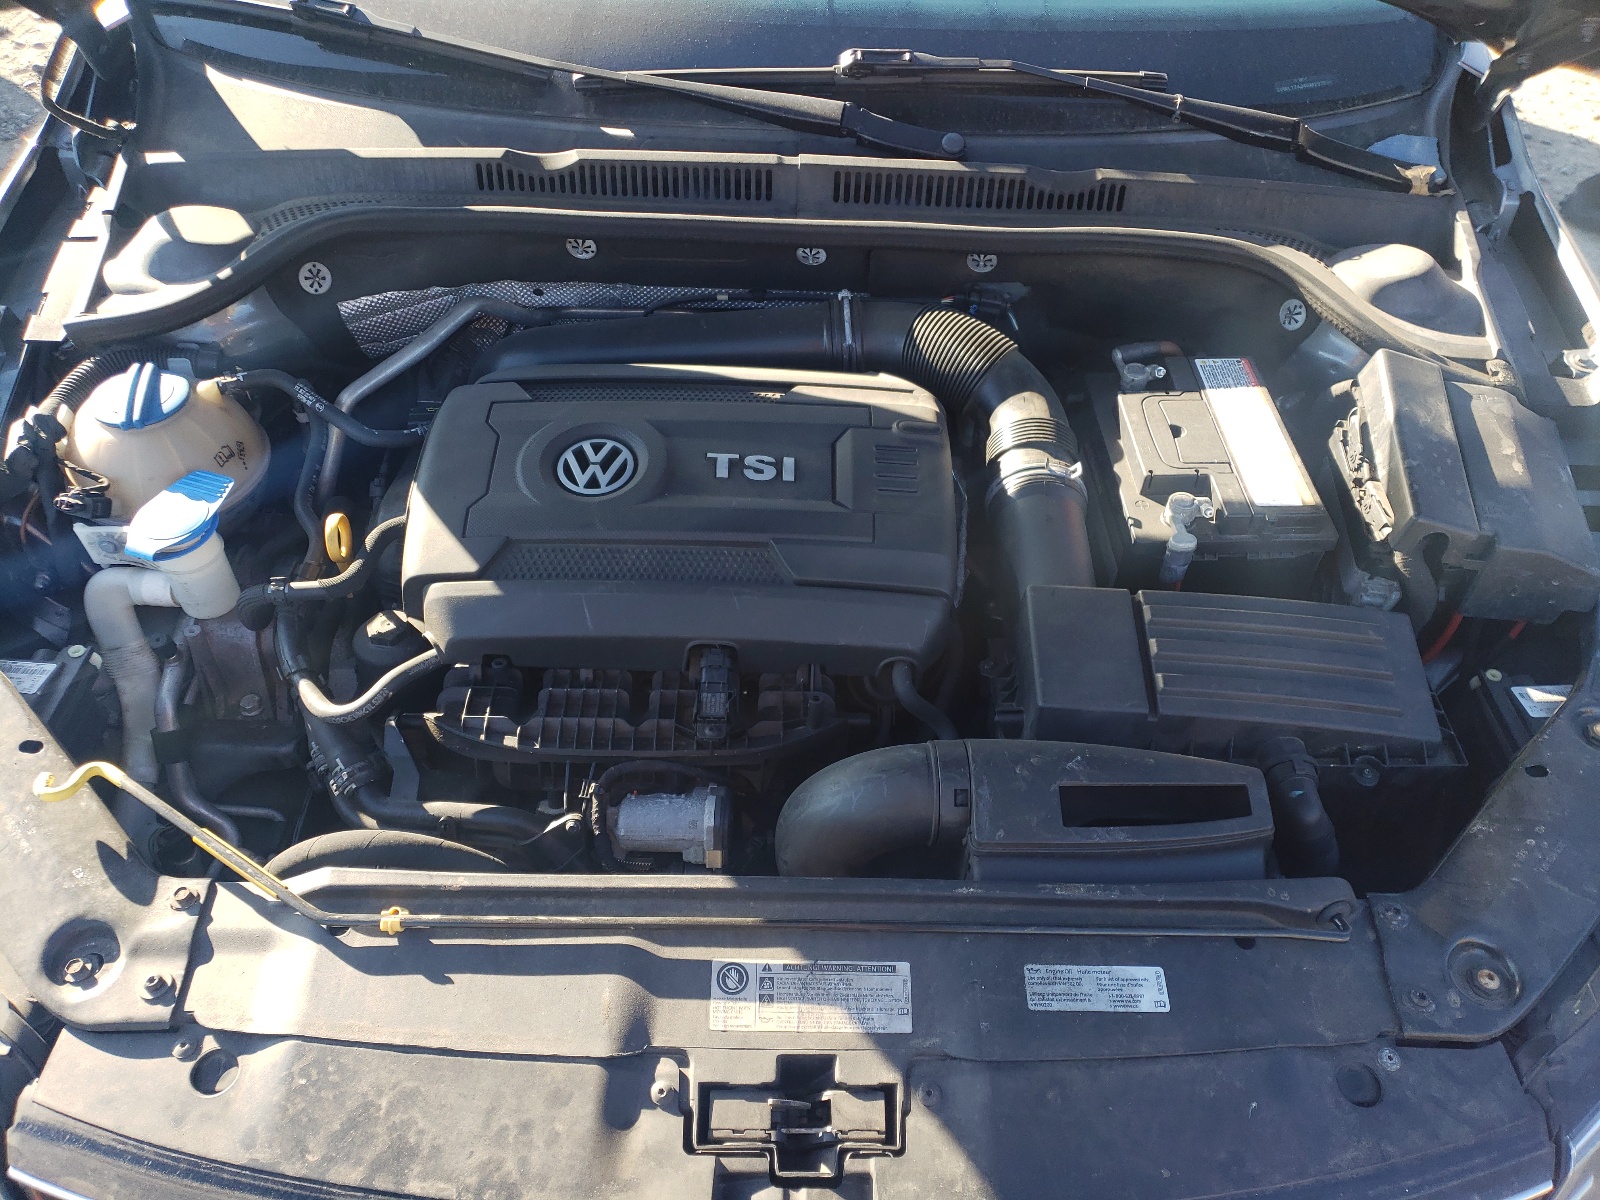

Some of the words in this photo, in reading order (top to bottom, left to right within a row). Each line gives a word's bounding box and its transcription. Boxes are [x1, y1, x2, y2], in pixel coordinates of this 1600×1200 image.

[557, 438, 634, 495] VW
[706, 452, 795, 482] TSI
[857, 965, 894, 973] ATTENTION!
